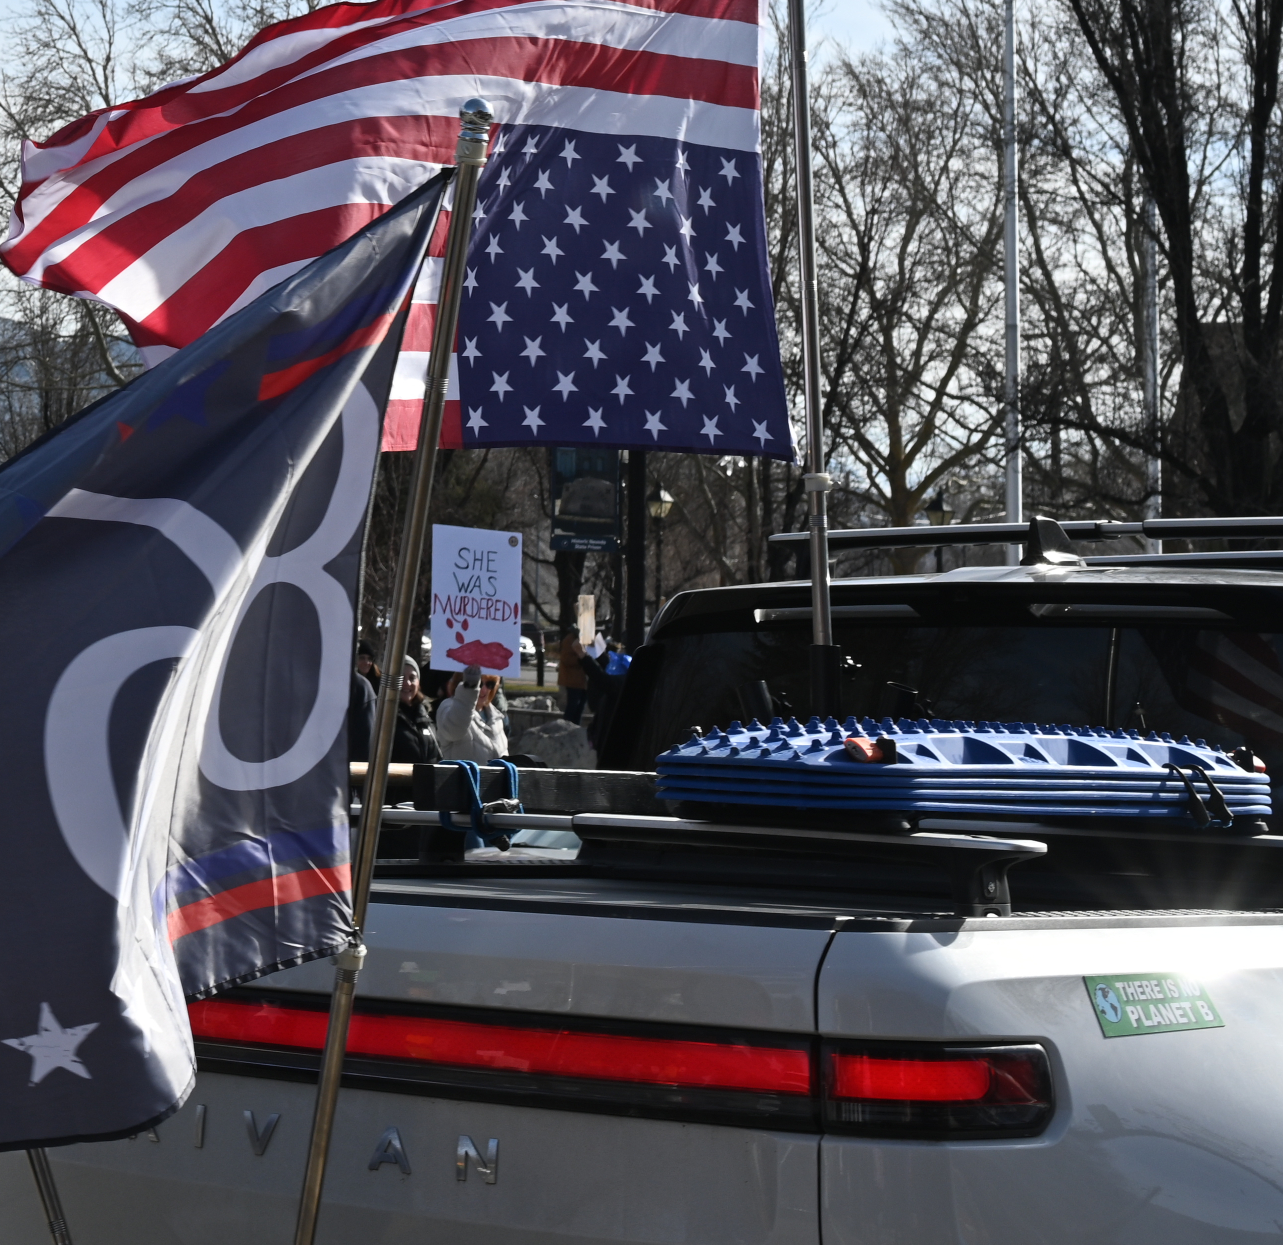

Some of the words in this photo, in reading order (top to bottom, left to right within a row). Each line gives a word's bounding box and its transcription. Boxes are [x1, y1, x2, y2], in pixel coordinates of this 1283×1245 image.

[454, 547, 498, 573] SHE
[452, 571, 497, 597] WAS
[433, 593, 519, 625] MURDERED!
[1115, 980, 1165, 1001] THERE
[1162, 978, 1179, 998] IS
[1178, 978, 1201, 997] NO
[1125, 1002, 1197, 1028] PLANET
[1195, 1000, 1214, 1021] B
